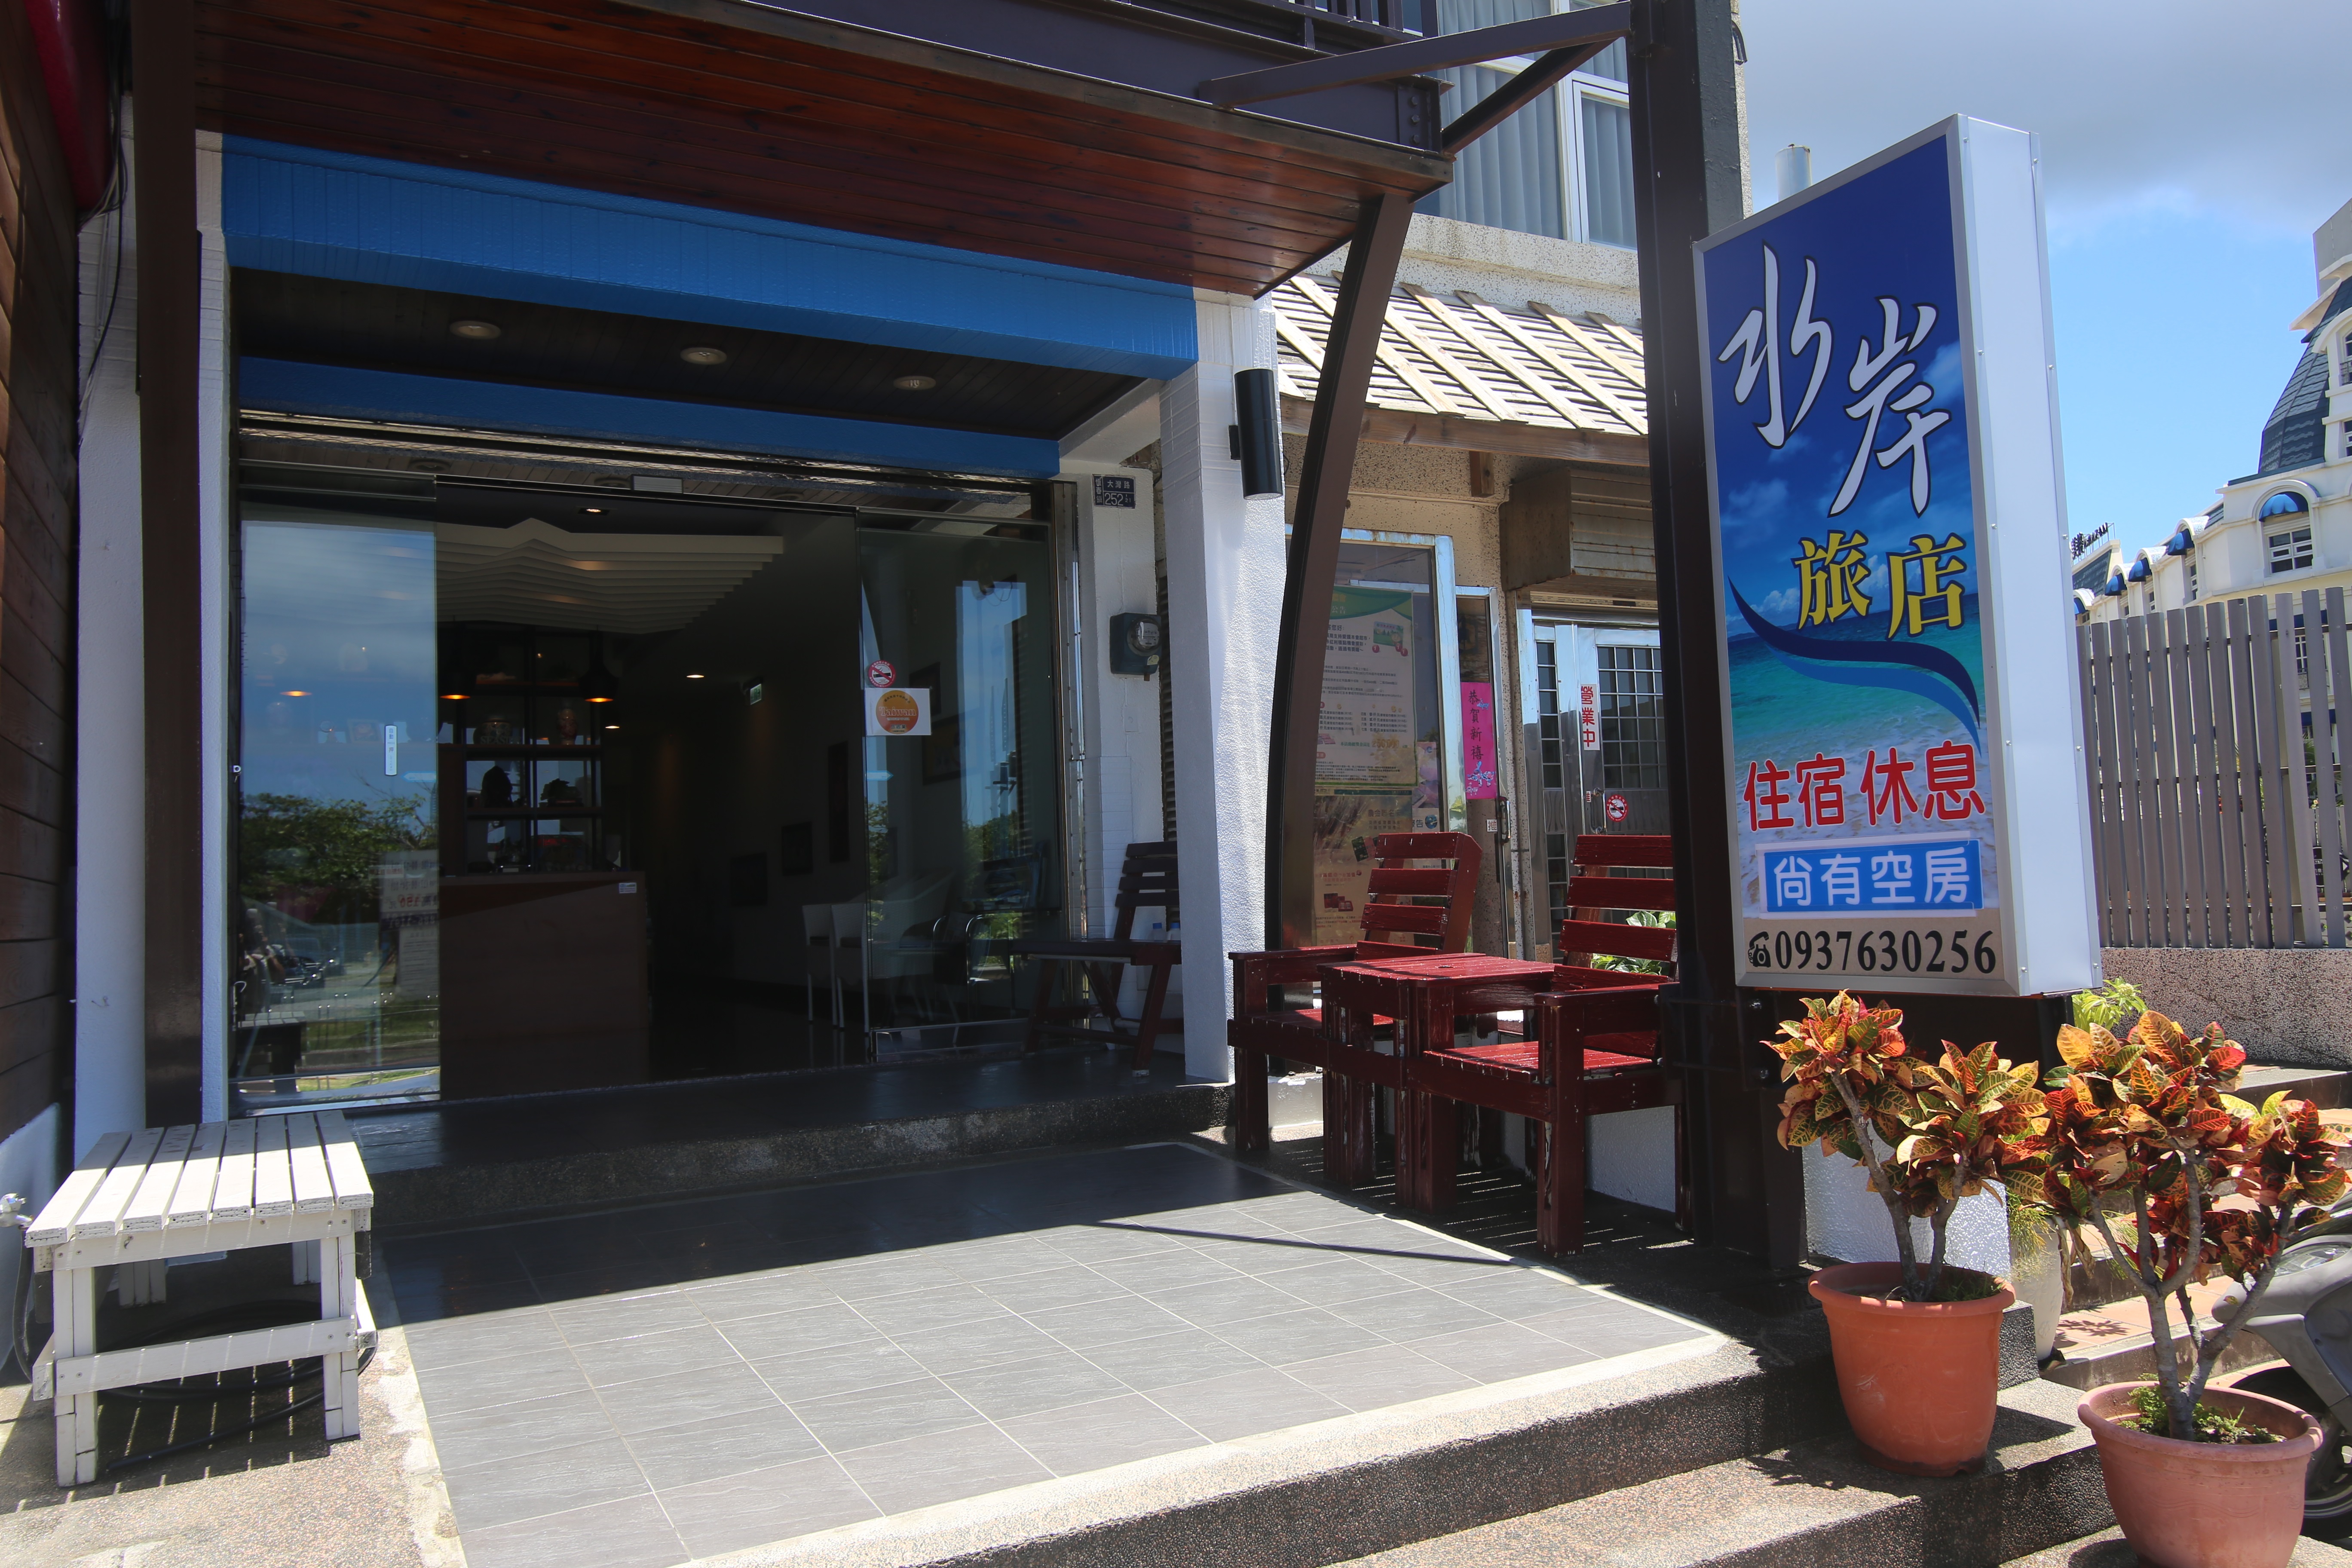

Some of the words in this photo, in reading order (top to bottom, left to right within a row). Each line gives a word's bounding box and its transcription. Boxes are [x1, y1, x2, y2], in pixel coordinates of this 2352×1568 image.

[1717, 239, 1952, 518] 水岸
[1105, 493, 1124, 506] 252
[1107, 480, 1130, 489] 大灣路
[1791, 529, 1967, 641] 旅店
[879, 706, 916, 716] Taiwan
[1468, 689, 1484, 760] 恭賀新禧
[1581, 686, 1596, 748] 營業中
[1743, 740, 1985, 832] 住宿休息
[1488, 820, 1497, 831] 推
[1773, 846, 1970, 906] 尚有空房
[1775, 929, 1997, 974] 0937630256
